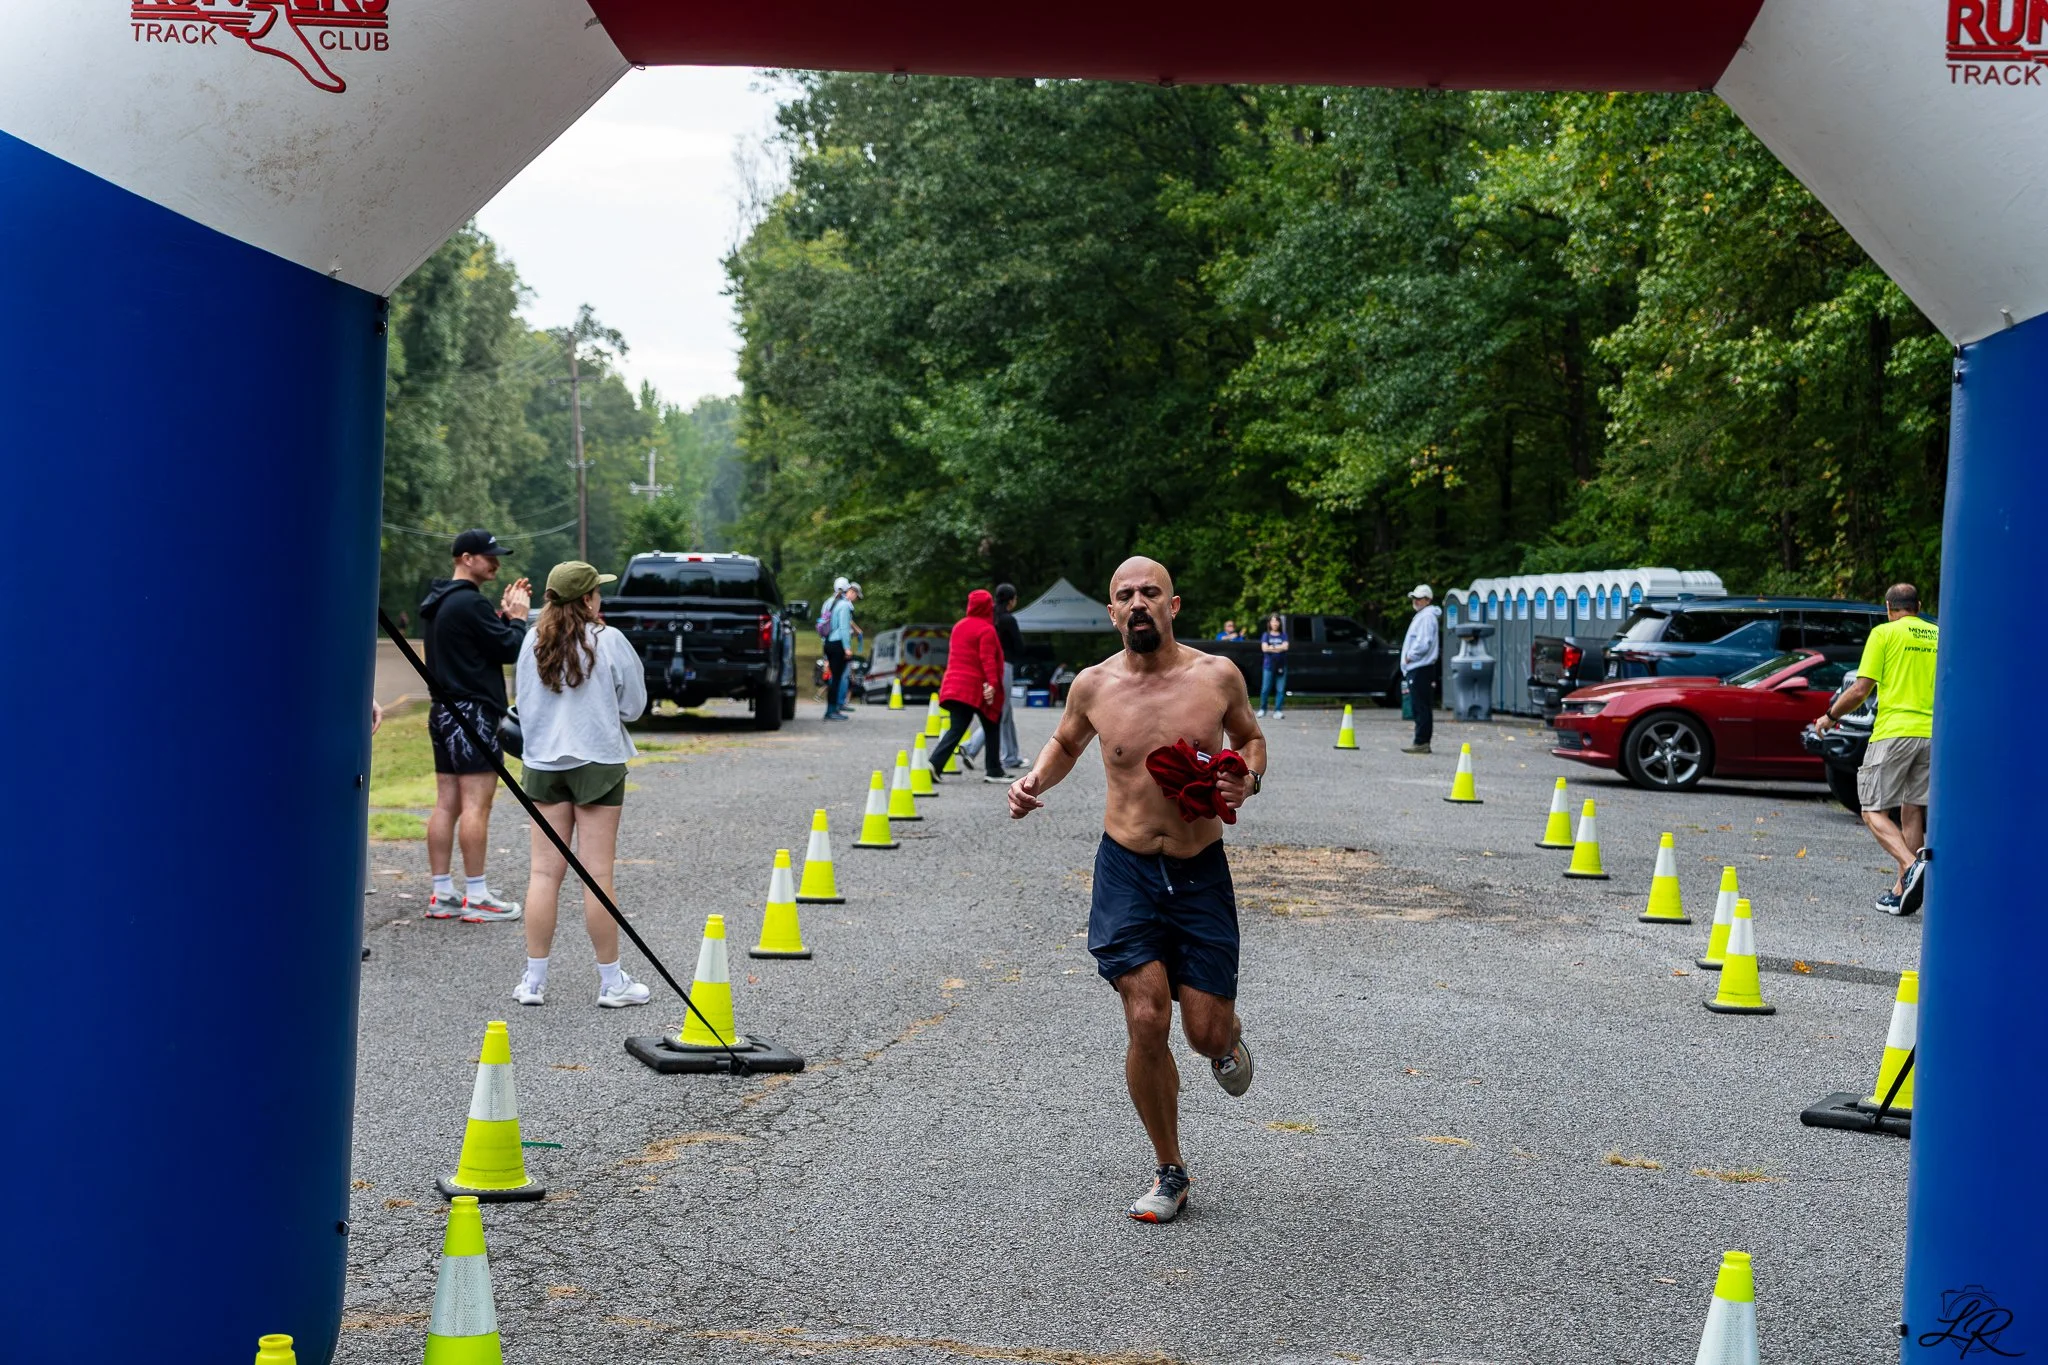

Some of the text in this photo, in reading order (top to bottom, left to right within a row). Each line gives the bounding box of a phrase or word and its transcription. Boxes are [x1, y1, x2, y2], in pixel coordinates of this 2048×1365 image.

[131, 22, 389, 51] TRACK CLUB
[1946, 64, 2041, 86] TRACK
